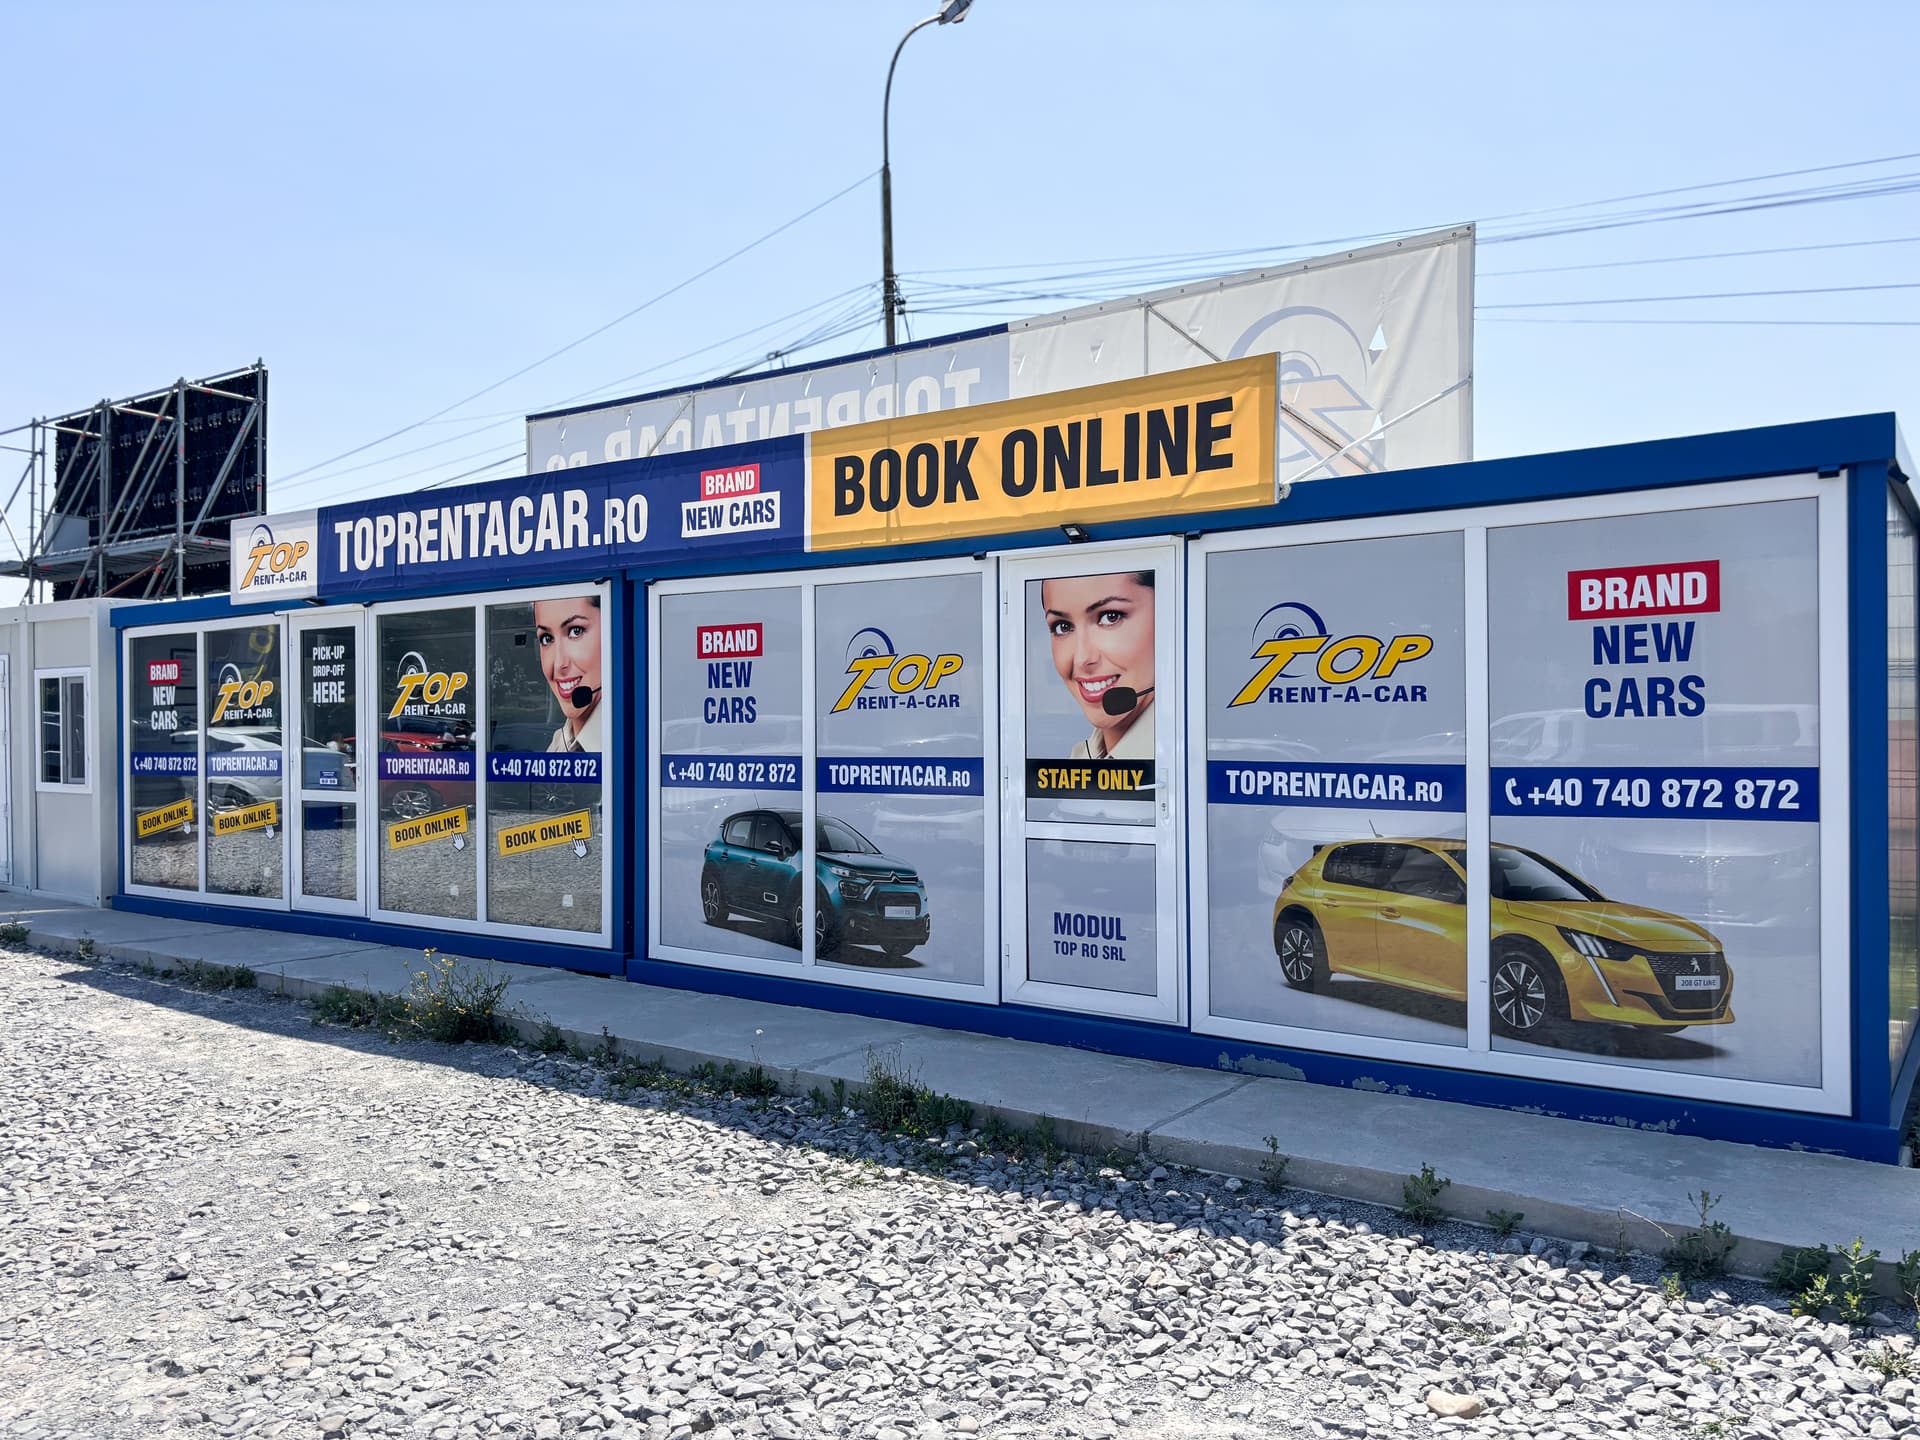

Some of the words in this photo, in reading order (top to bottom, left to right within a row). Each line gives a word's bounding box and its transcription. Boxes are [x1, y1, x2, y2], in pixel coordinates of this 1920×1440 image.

[834, 436, 980, 517] BOOK
[1000, 396, 1234, 498] ONLINE
[705, 469, 756, 496] BRAND
[685, 505, 727, 532] NEW
[729, 498, 776, 525] CARS
[334, 488, 649, 574] TOPRENTACAR.RO
[240, 540, 310, 591] TOP
[254, 570, 308, 586] RENT-A-CAR
[1580, 571, 1707, 612] BRAND
[312, 645, 345, 660] PICK-UP
[702, 628, 758, 653] BRAND
[1592, 621, 1695, 665] NEW
[150, 663, 178, 681] BRAND
[312, 665, 345, 677] DROP-OFF
[707, 661, 752, 689] NEW
[830, 653, 964, 714] TOP
[1226, 634, 1434, 709] TOP
[153, 686, 175, 705] NEW
[211, 680, 273, 723] TOP
[312, 681, 345, 704] HERE
[387, 672, 468, 720] TOP
[857, 694, 960, 710] RENT-A-CAR
[1268, 685, 1427, 704] RENT-A-CAR
[1584, 674, 1706, 719] CARS
[151, 710, 178, 730] CARS
[224, 708, 273, 720] RENT-A-CAR
[404, 703, 467, 717] RENT-A-CAR
[704, 696, 757, 724] CARS
[139, 757, 153, 772] +40
[154, 757, 167, 772] 740
[168, 757, 182, 772] 872
[183, 758, 197, 773] 872
[211, 757, 278, 772] TOPRENTACAR.RO
[386, 757, 470, 776] TOPRENTACAR.RO
[500, 758, 522, 777] +40
[524, 758, 547, 777] 740
[549, 758, 572, 778] 872
[574, 758, 597, 778] 872
[678, 762, 703, 781] +40
[708, 762, 734, 782] 740
[738, 762, 765, 782] 872
[769, 763, 796, 783] 872
[829, 764, 970, 787] TOPRENTACAR.RO
[1037, 768, 1092, 790] STAFF
[1097, 768, 1144, 791] ONLY
[1226, 769, 1443, 803] TOPRENTACAR.RO
[1527, 778, 1583, 807] +40
[1592, 779, 1651, 808] 740
[1661, 779, 1723, 809] 872
[1734, 779, 1800, 810] 872
[142, 818, 161, 831] BOOK
[163, 805, 189, 827] ONLINE
[218, 818, 241, 831] BOOK
[243, 807, 272, 826] ONLINE
[395, 825, 422, 843] BOOK
[424, 815, 461, 836] ONLINE
[505, 828, 538, 849] BOOK
[540, 819, 583, 843] ONLINE
[1053, 911, 1127, 941] MODUL
[1054, 940, 1077, 956] TOP
[1081, 943, 1098, 958] RO
[1102, 945, 1126, 962] SRL
